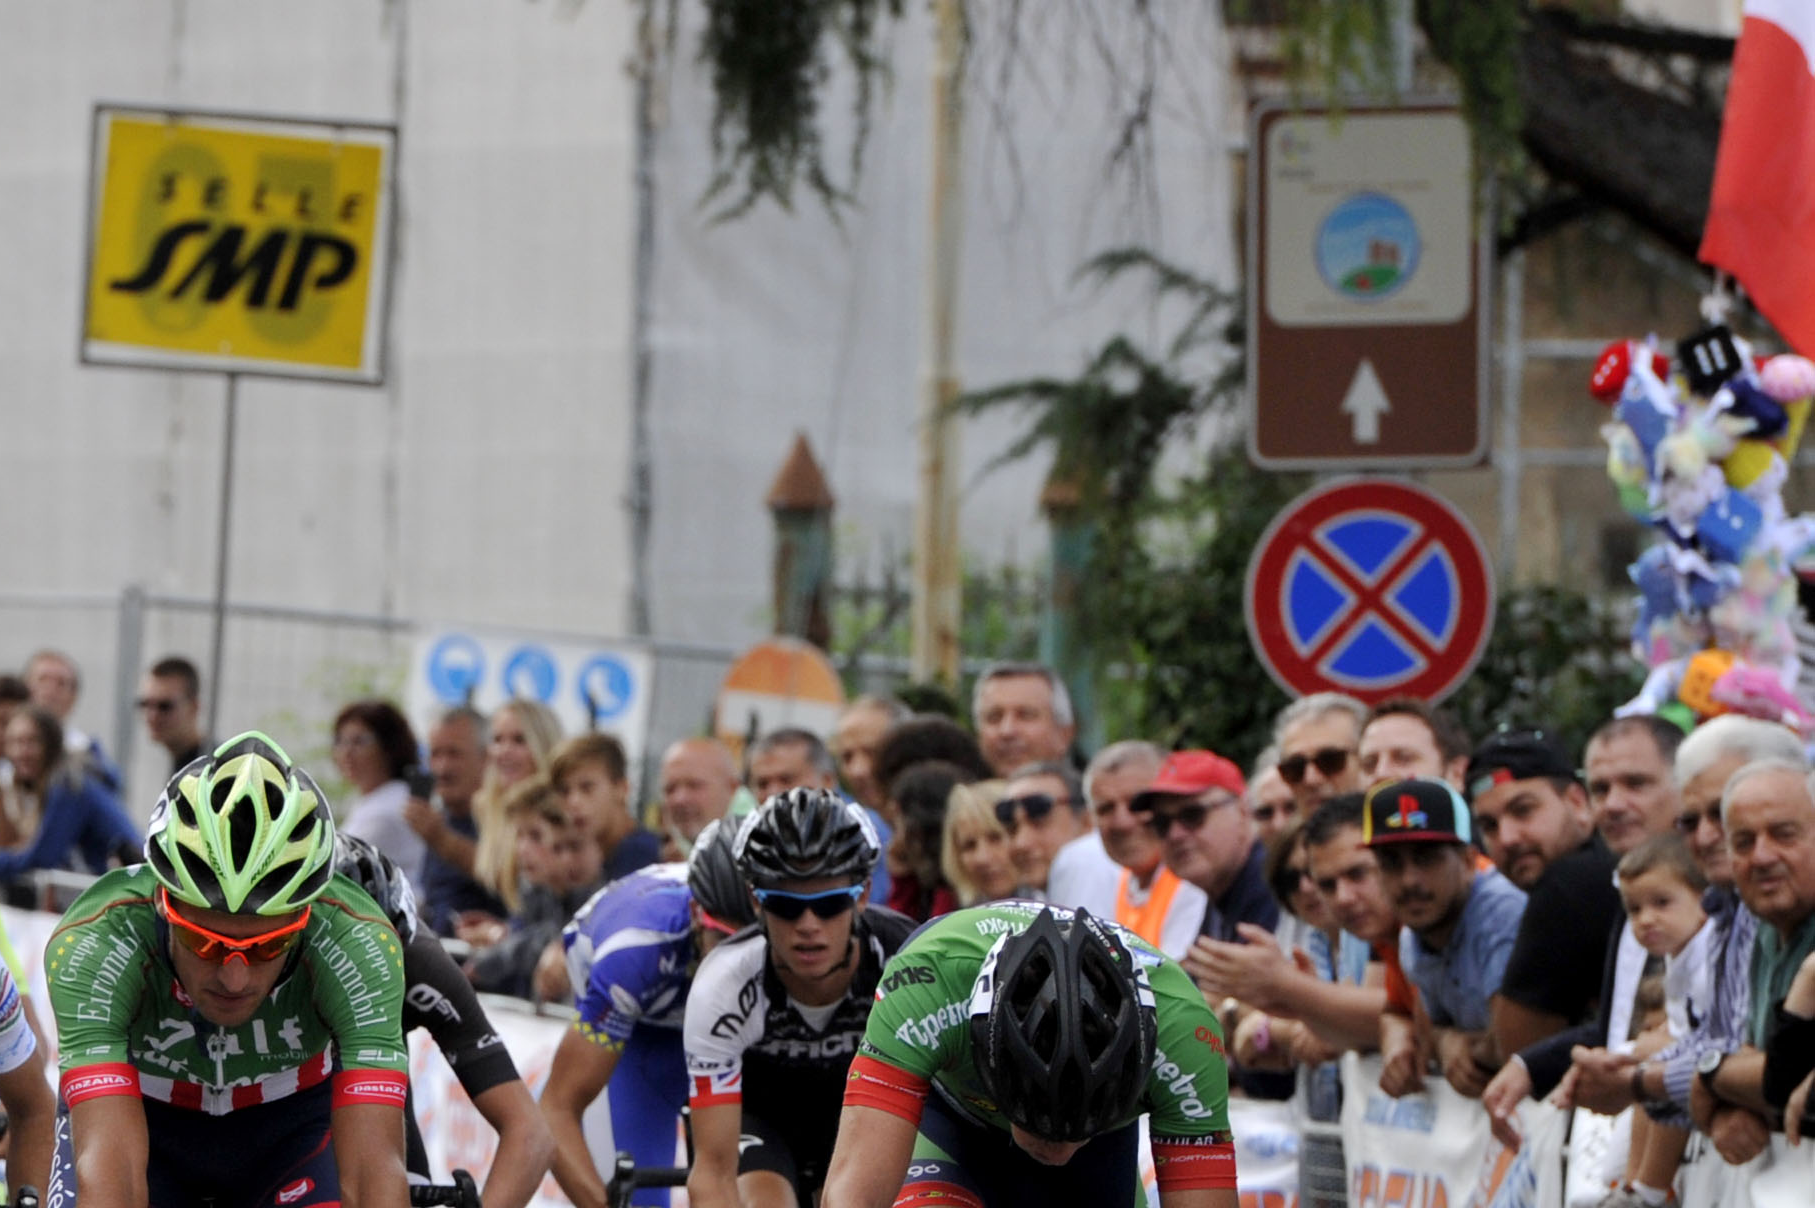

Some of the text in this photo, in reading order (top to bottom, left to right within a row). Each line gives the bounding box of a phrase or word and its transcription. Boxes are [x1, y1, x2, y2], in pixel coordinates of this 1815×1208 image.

[159, 170, 362, 222] SELLE
[110, 219, 358, 313] SMP
[351, 922, 392, 982] Gruppo
